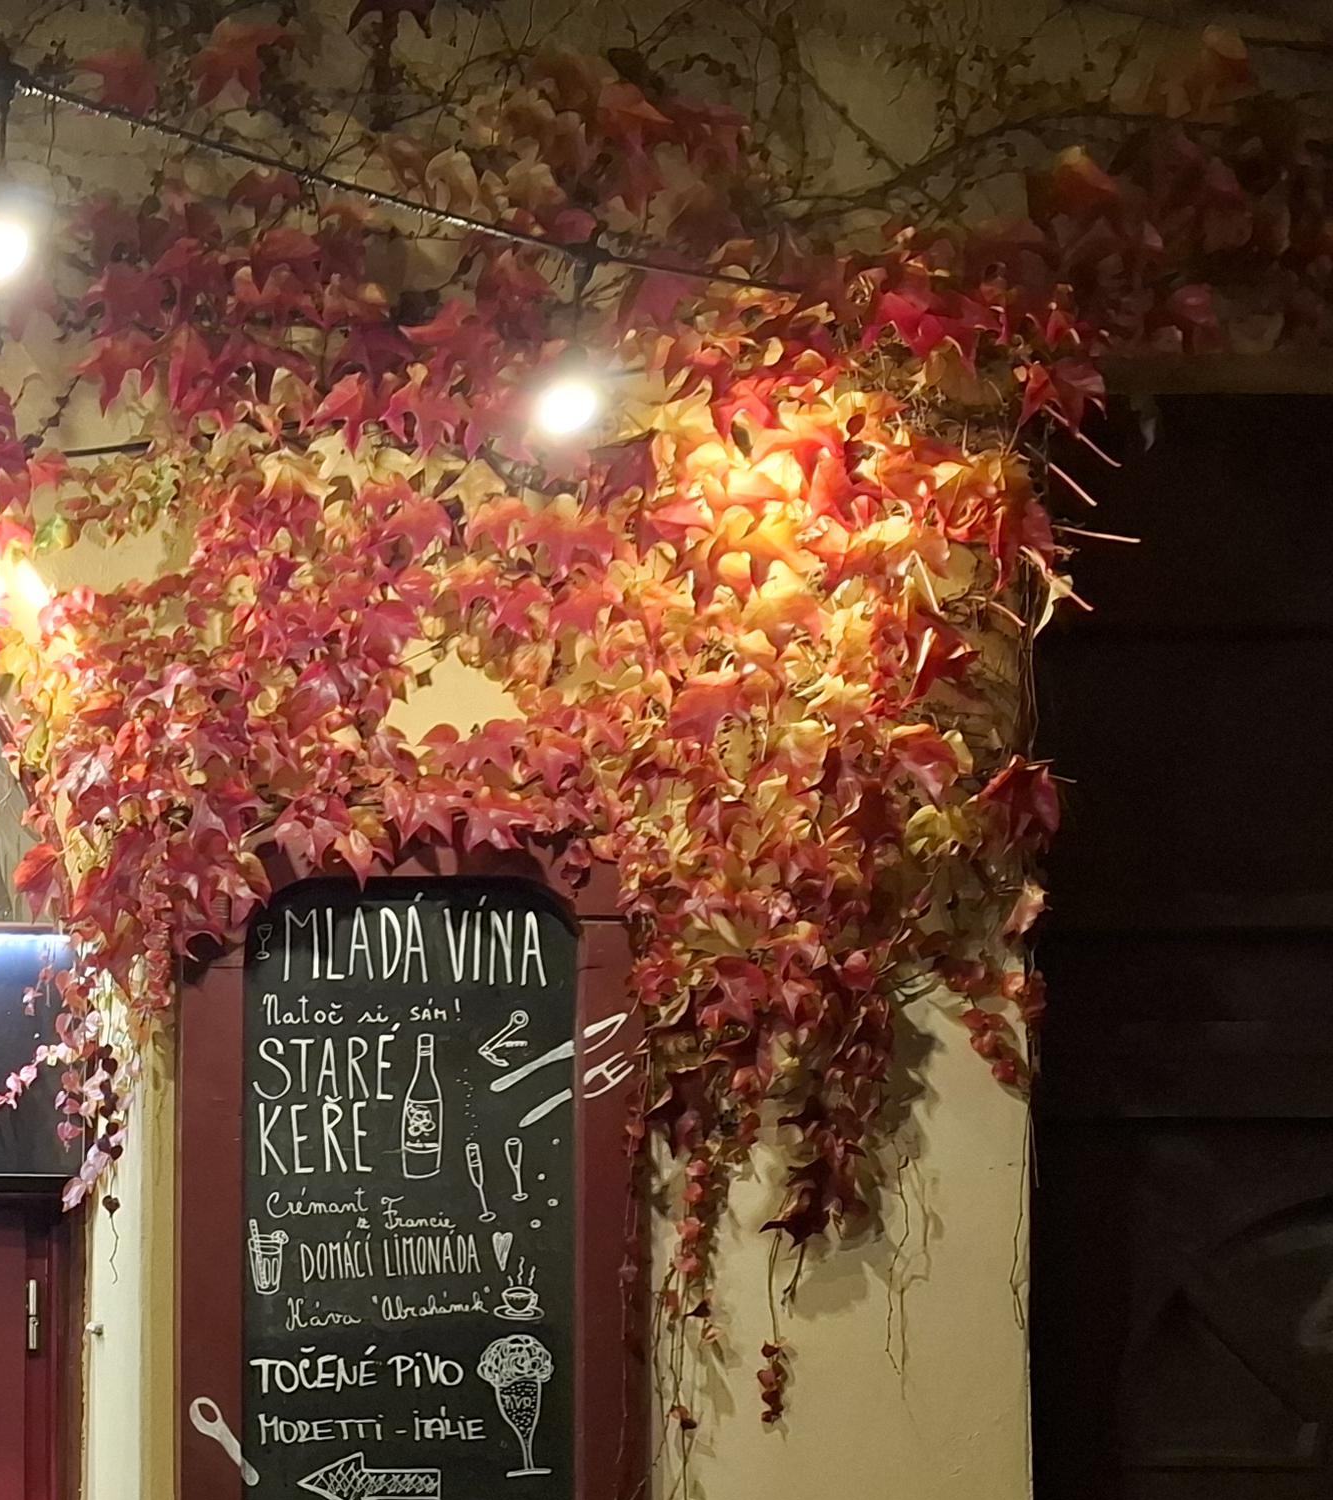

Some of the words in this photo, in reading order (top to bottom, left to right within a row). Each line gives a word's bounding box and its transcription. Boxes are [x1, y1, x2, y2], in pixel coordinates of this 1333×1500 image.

[282, 892, 430, 984] MLADÁ
[443, 894, 547, 987] VÍNA
[263, 993, 344, 1026] Natoč
[356, 1003, 389, 1024] si
[252, 1023, 401, 1101] STARÉ
[257, 1095, 374, 1176] KEŘE
[266, 1187, 368, 1218] Crémant
[381, 1196, 456, 1230] Francie
[299, 1231, 373, 1282] DOMÁCÍ
[384, 1230, 481, 1278] LIMONÁDA
[285, 1297, 362, 1331] Káva
[249, 1345, 379, 1393] TOČENÉ
